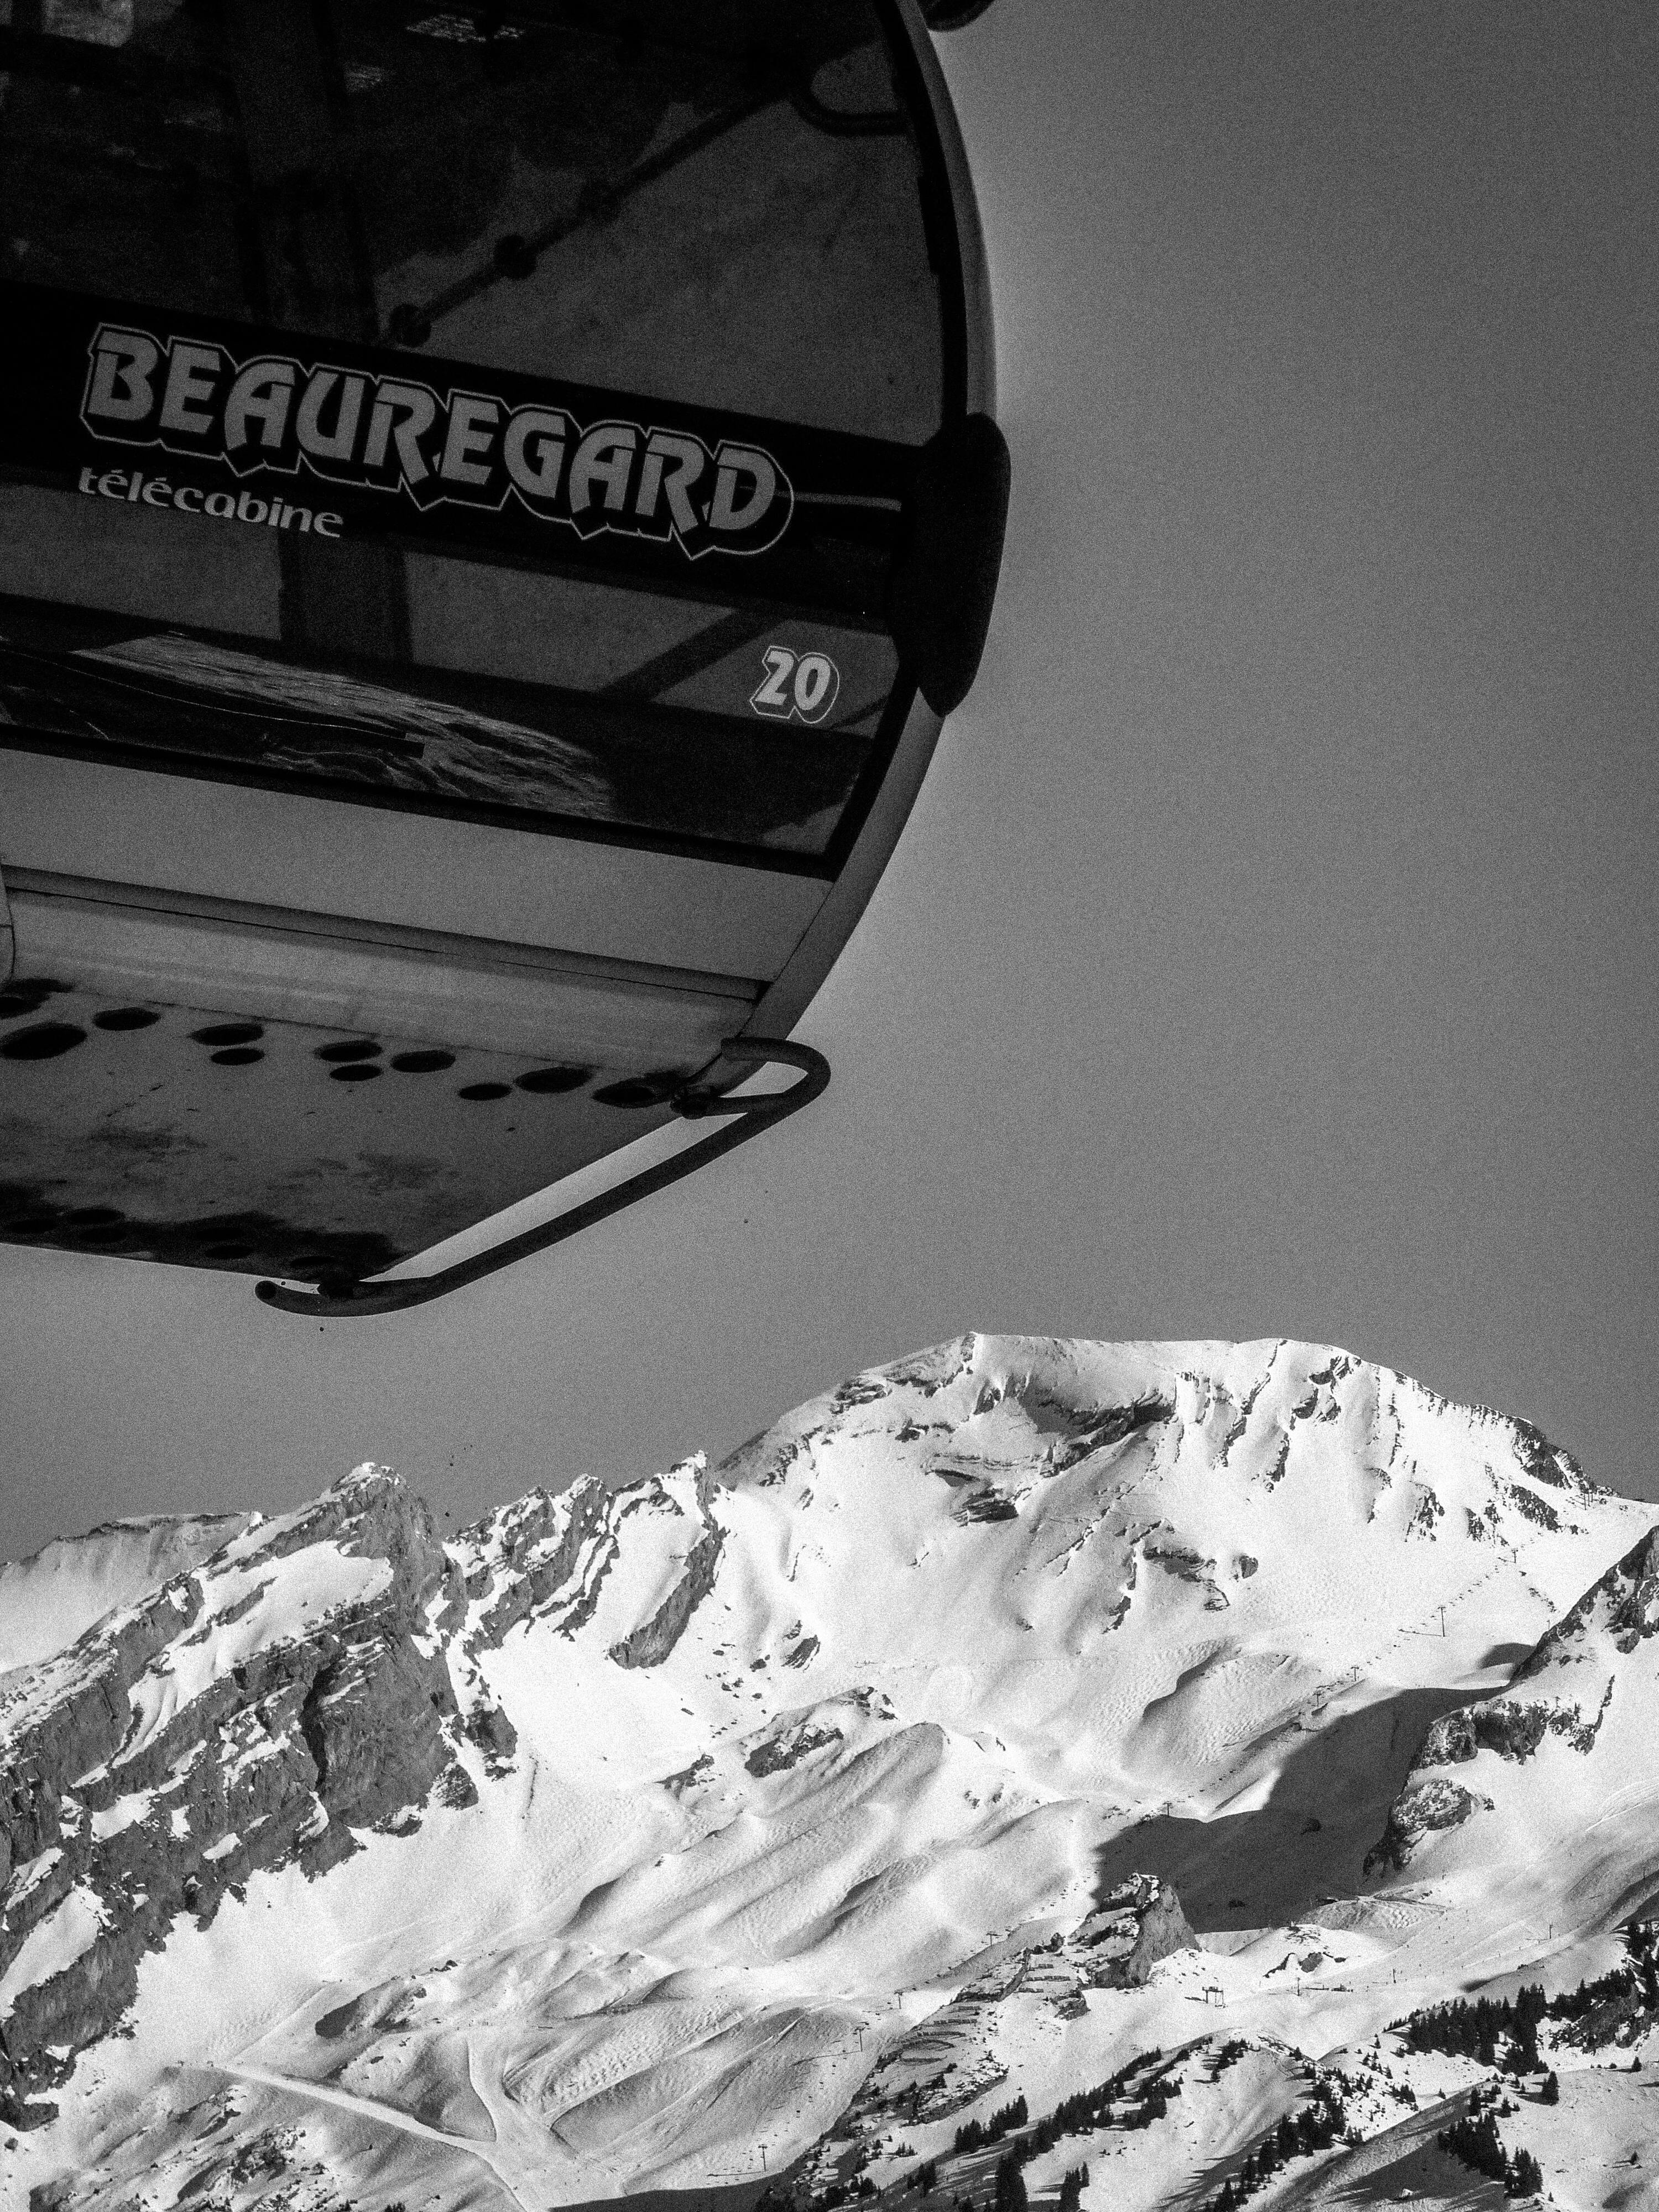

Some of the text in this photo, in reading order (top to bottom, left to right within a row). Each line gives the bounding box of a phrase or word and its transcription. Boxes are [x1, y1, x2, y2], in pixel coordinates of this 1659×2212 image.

[83, 326, 782, 545] BEAUREGARD
[79, 467, 343, 538] télécabine
[753, 648, 835, 717] 20
